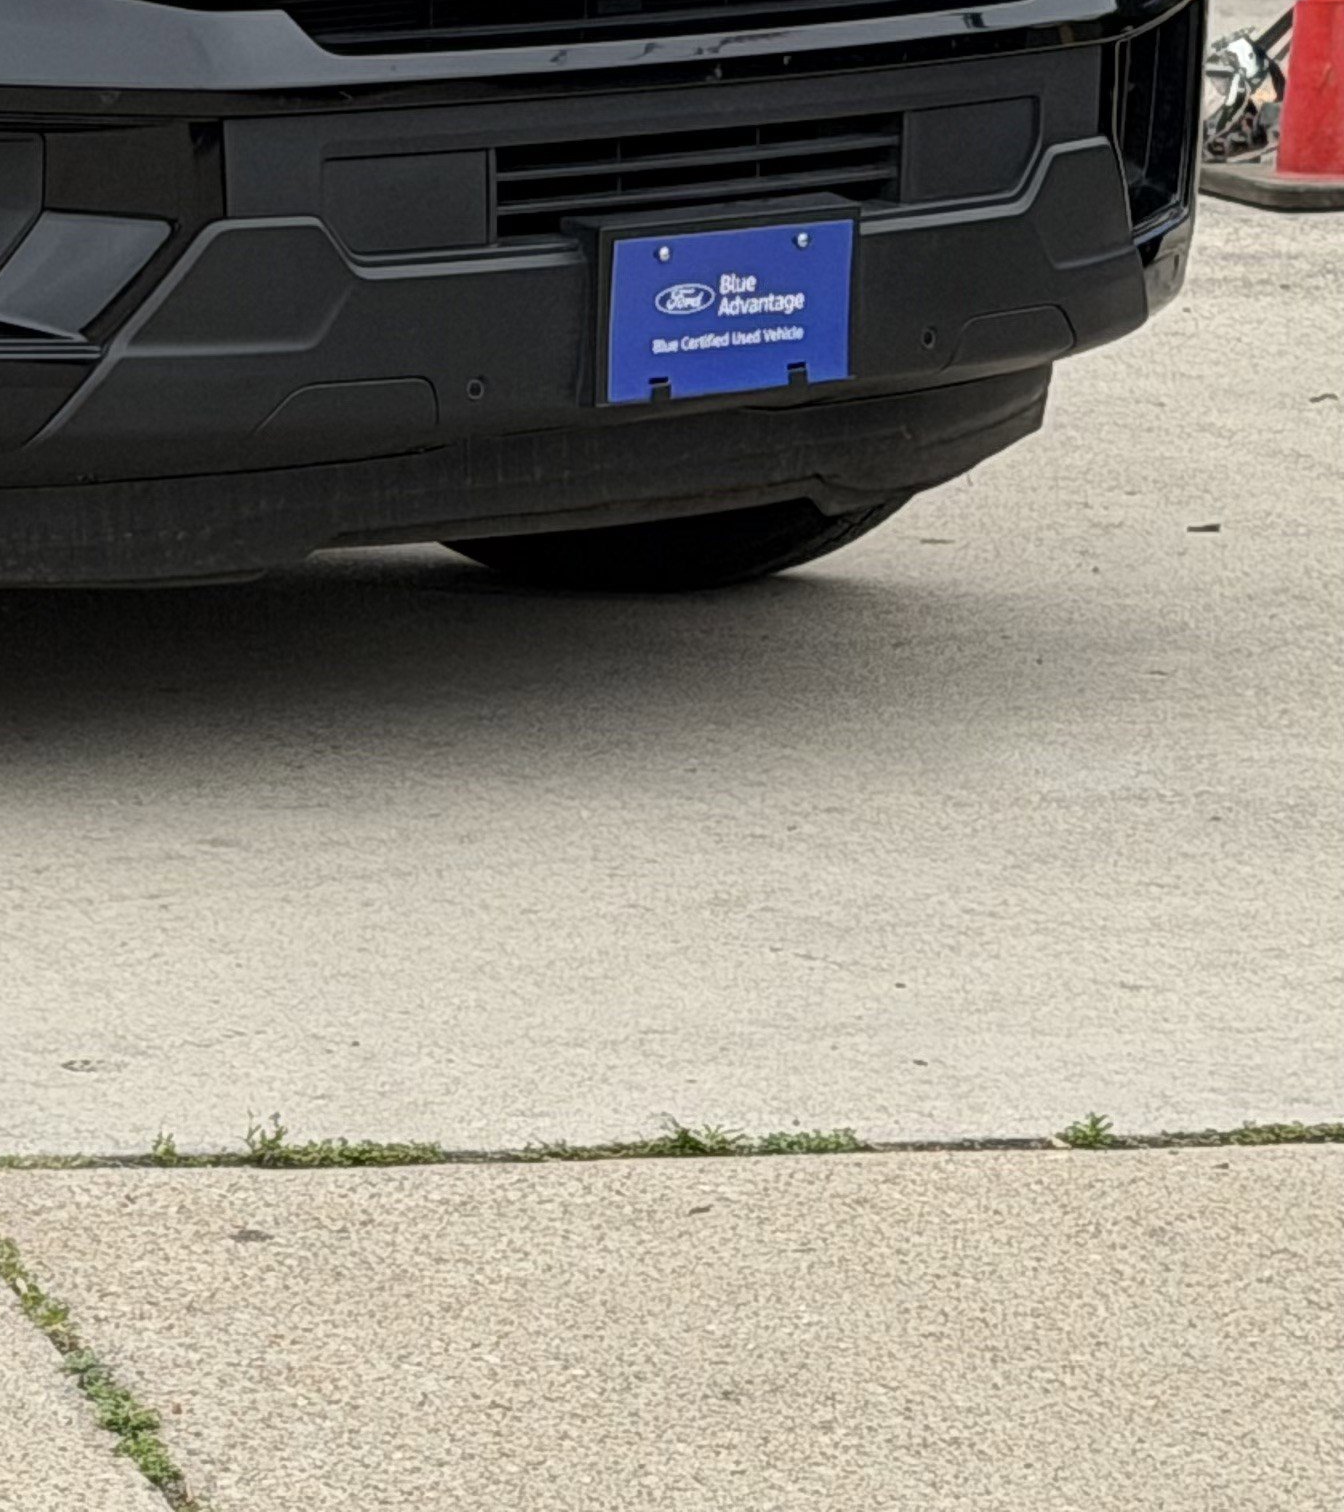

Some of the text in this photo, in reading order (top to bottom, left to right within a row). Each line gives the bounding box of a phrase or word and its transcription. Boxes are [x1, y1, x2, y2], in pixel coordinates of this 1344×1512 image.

[719, 272, 757, 295] Blue
[665, 287, 704, 311] Ford
[717, 292, 806, 317] Advantage
[652, 324, 805, 354] Blue Certified Used Vehicle
